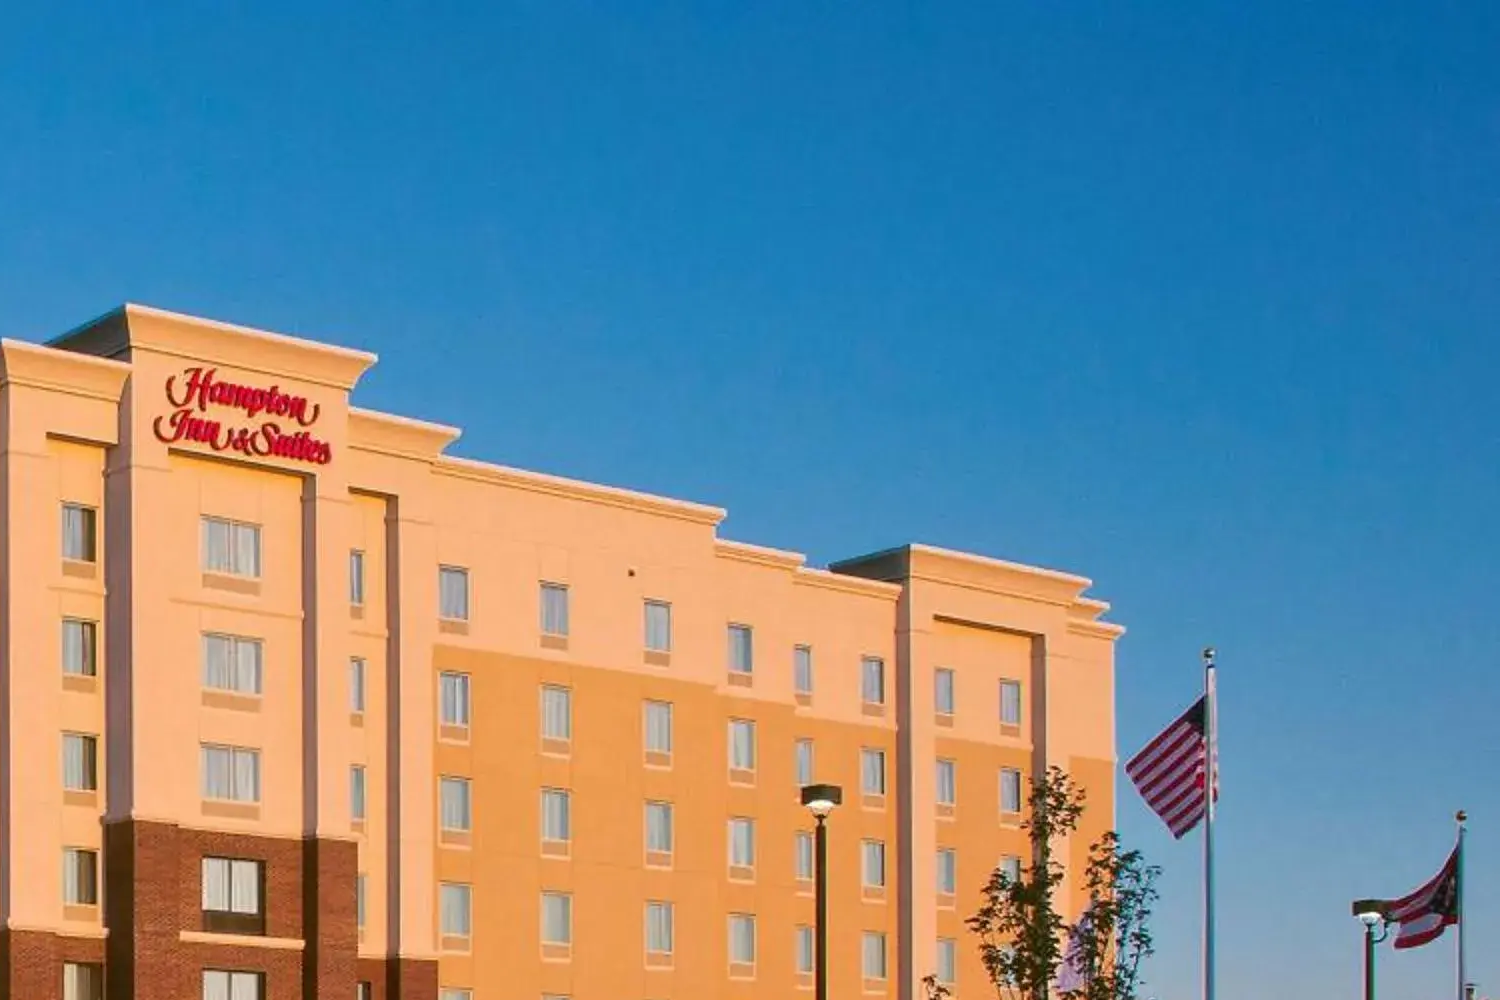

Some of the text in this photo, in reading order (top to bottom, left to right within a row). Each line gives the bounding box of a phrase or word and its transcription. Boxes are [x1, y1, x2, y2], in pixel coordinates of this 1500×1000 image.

[165, 367, 320, 426] Hampton
[153, 408, 332, 465] Inn & Suites
